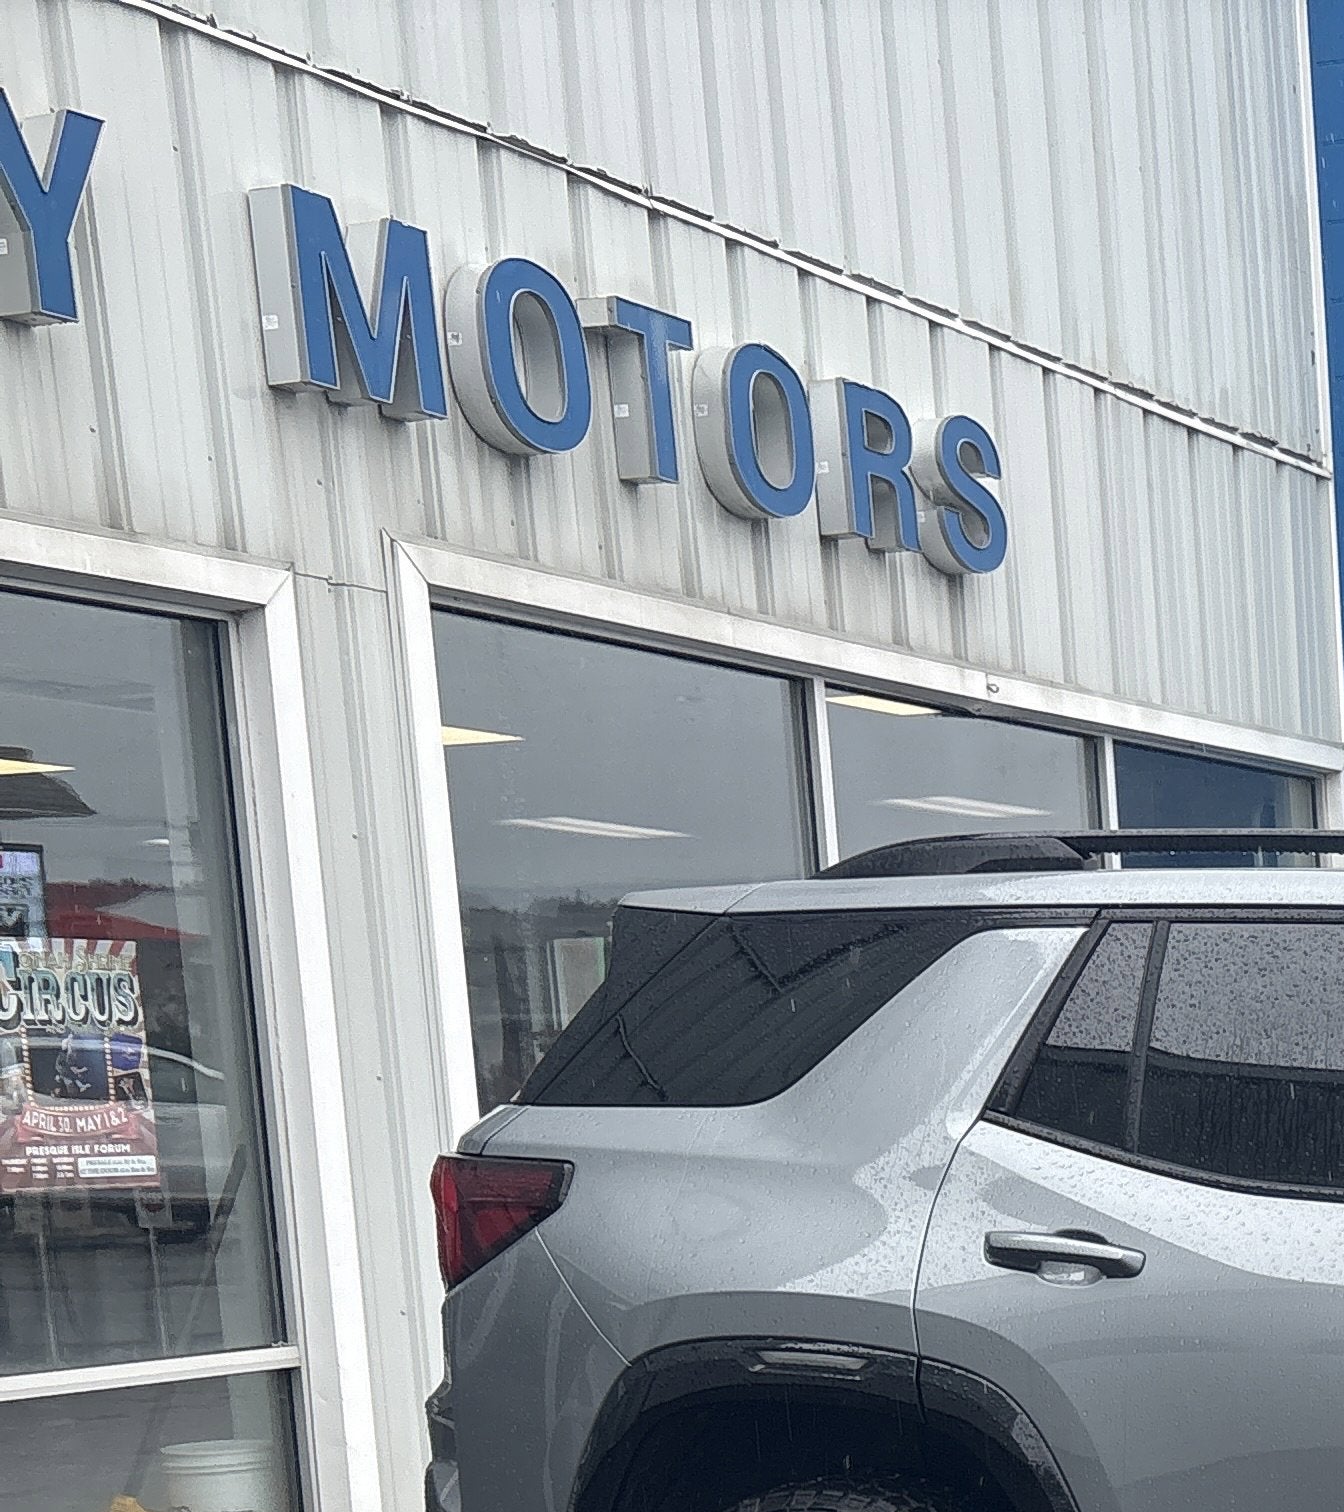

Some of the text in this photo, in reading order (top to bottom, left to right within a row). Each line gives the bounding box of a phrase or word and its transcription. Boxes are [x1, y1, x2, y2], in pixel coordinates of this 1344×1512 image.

[249, 183, 1007, 576] MOTORS
[22, 1110, 57, 1132] APRIL
[75, 1112, 103, 1133] MAY
[25, 1143, 70, 1157] PRESQUE
[94, 1143, 131, 1154] FORUM
